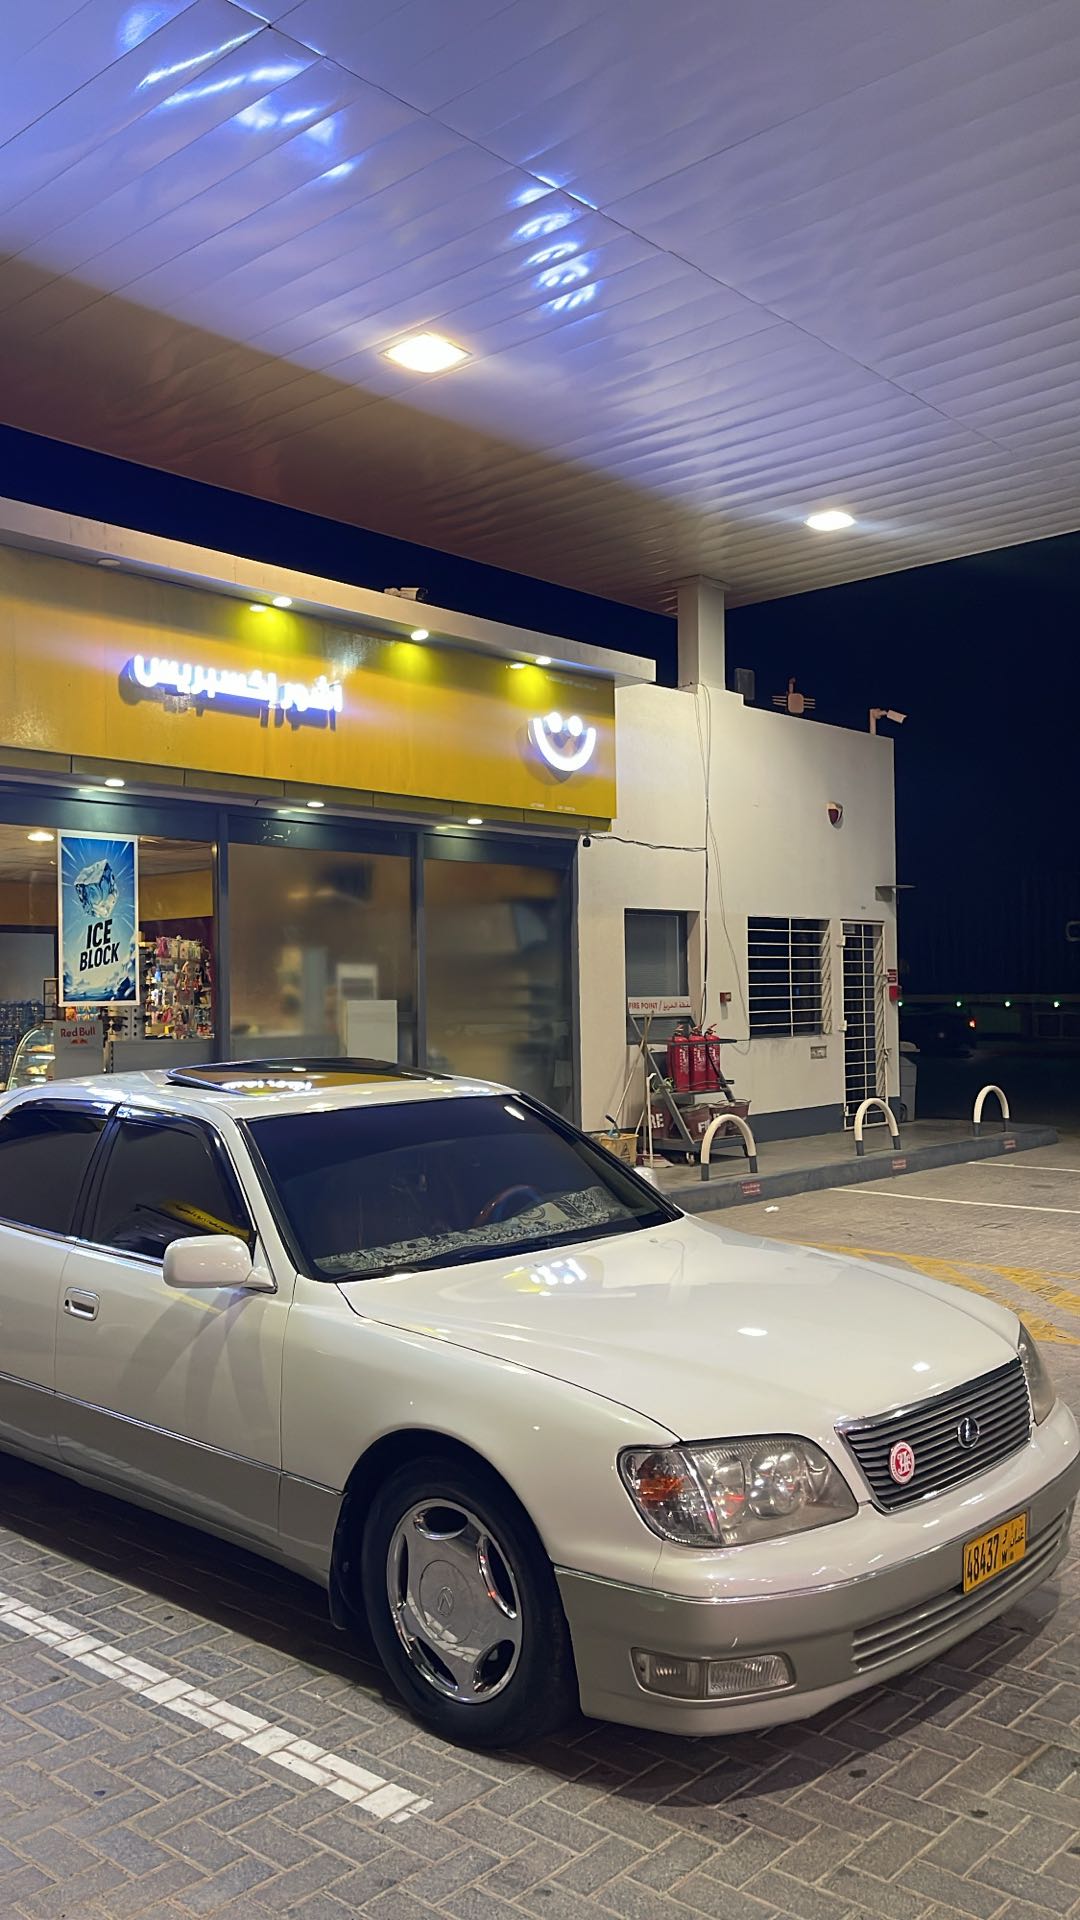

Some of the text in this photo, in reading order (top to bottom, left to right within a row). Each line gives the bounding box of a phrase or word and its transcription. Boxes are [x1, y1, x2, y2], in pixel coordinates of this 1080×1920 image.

[86, 919, 113, 949] ICE
[79, 942, 121, 972] BLOCK
[628, 1002, 640, 1010] FIRE
[641, 1002, 658, 1010] POINT
[60, 1026, 96, 1038] Red Bull
[966, 1533, 1000, 1584] 48437
[1001, 1550, 1008, 1565] W
